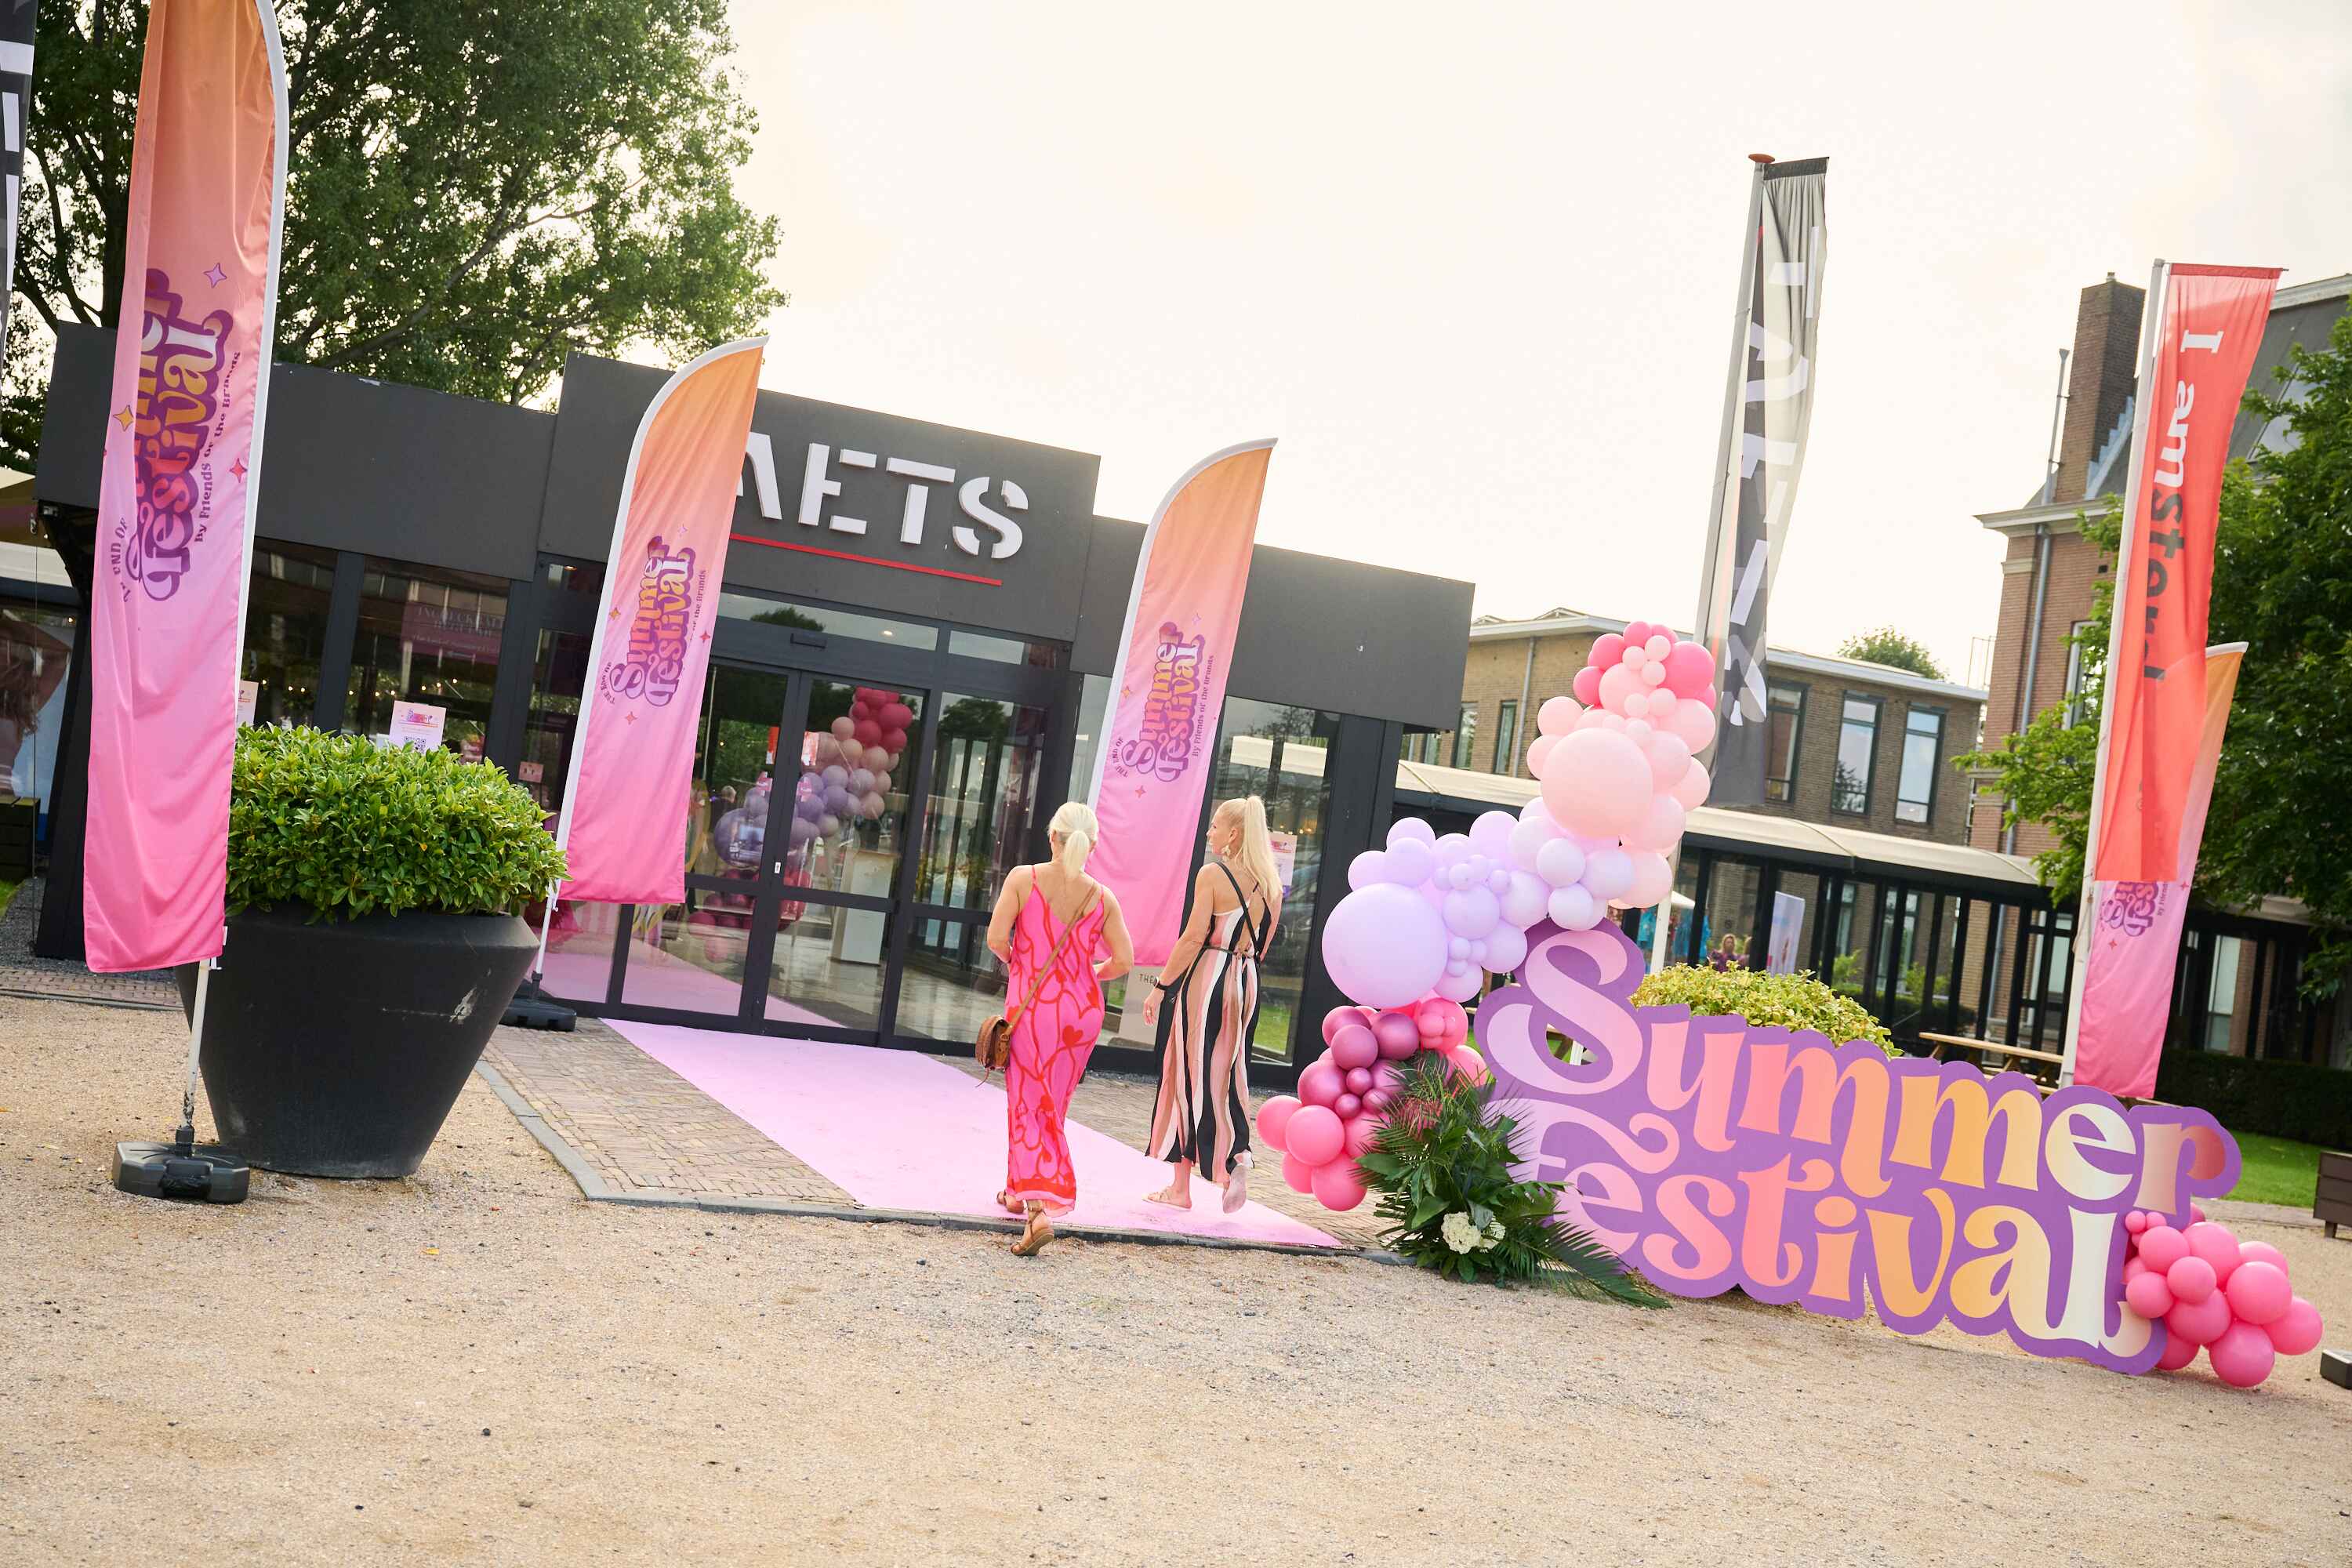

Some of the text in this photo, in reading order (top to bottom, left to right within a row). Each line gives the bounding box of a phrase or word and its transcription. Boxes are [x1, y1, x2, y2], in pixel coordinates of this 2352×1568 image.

[2180, 329, 2224, 354] I
[139, 311, 230, 601] Festival
[199, 463, 212, 518] Friends
[735, 432, 1029, 559] AETS
[610, 535, 668, 699] Summer
[644, 548, 695, 706] Festival
[1122, 622, 1181, 774] Summer
[1155, 634, 1205, 782] Festival
[1486, 930, 2227, 1215] Summer
[1482, 1098, 2152, 1358] Festival
